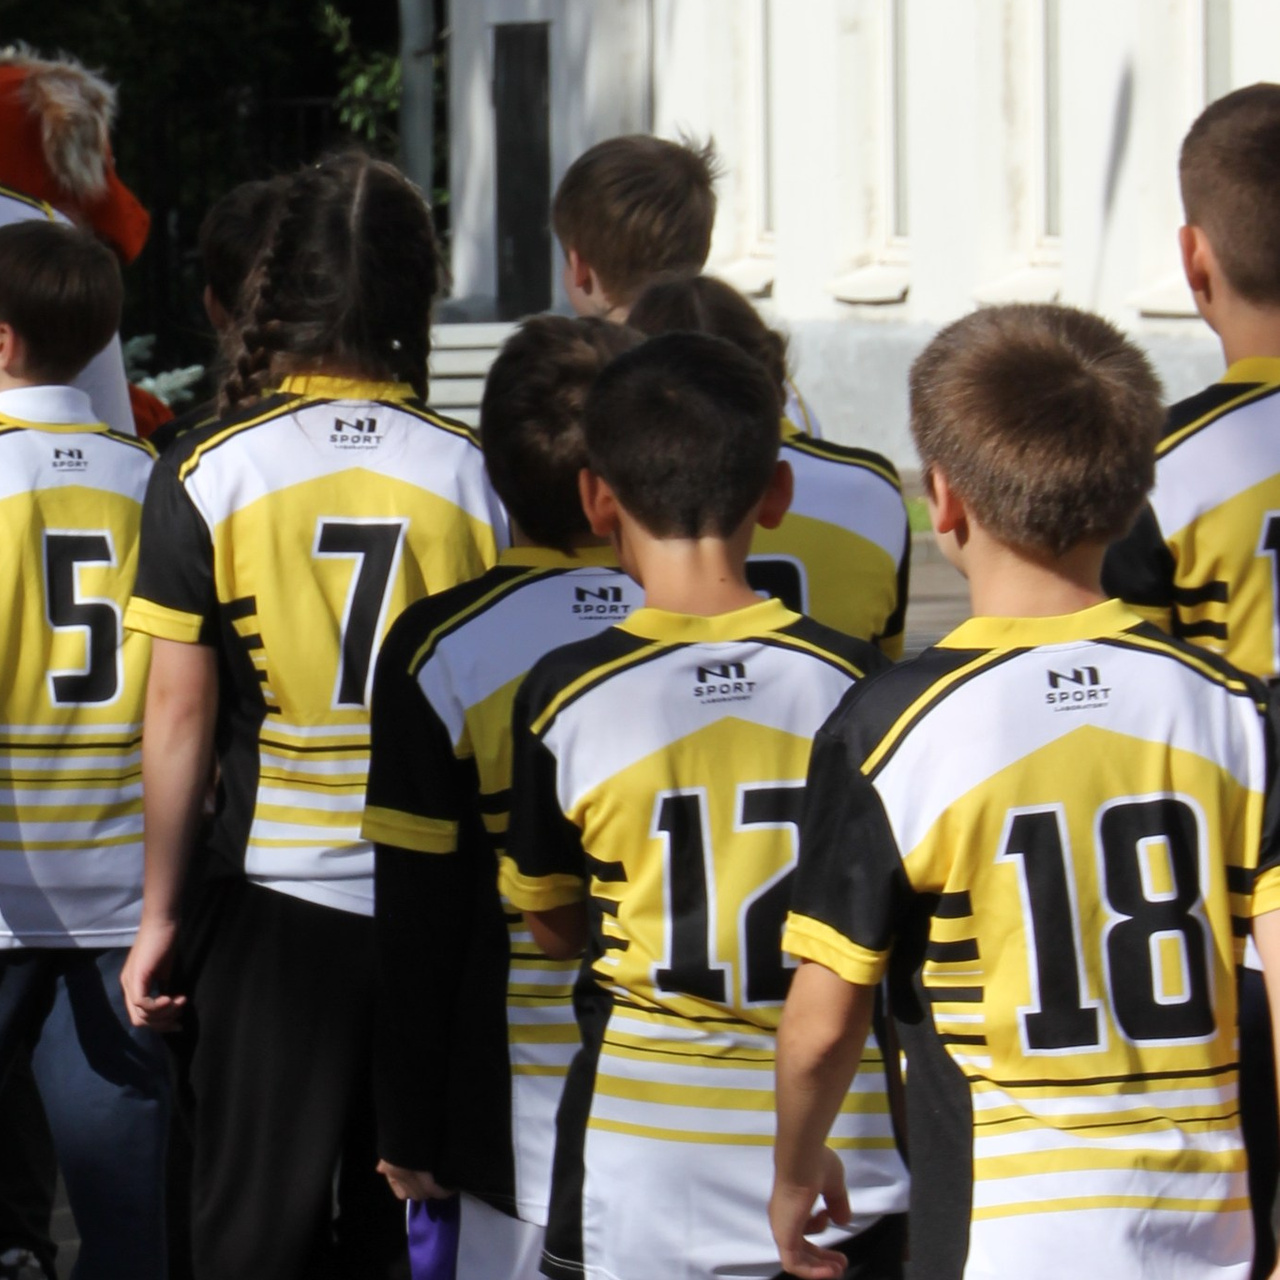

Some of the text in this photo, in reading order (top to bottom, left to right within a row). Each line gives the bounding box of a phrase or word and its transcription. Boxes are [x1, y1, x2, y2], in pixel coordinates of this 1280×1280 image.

[329, 434, 383, 444] SPORT
[51, 460, 89, 468] SPORT
[312, 516, 410, 710] 7
[571, 604, 631, 614] SPORT
[42, 528, 124, 709] 5
[693, 681, 756, 697] SPORT
[1045, 687, 1112, 704] SPORT
[649, 780, 807, 1009] 12
[996, 792, 1218, 1057] 18
